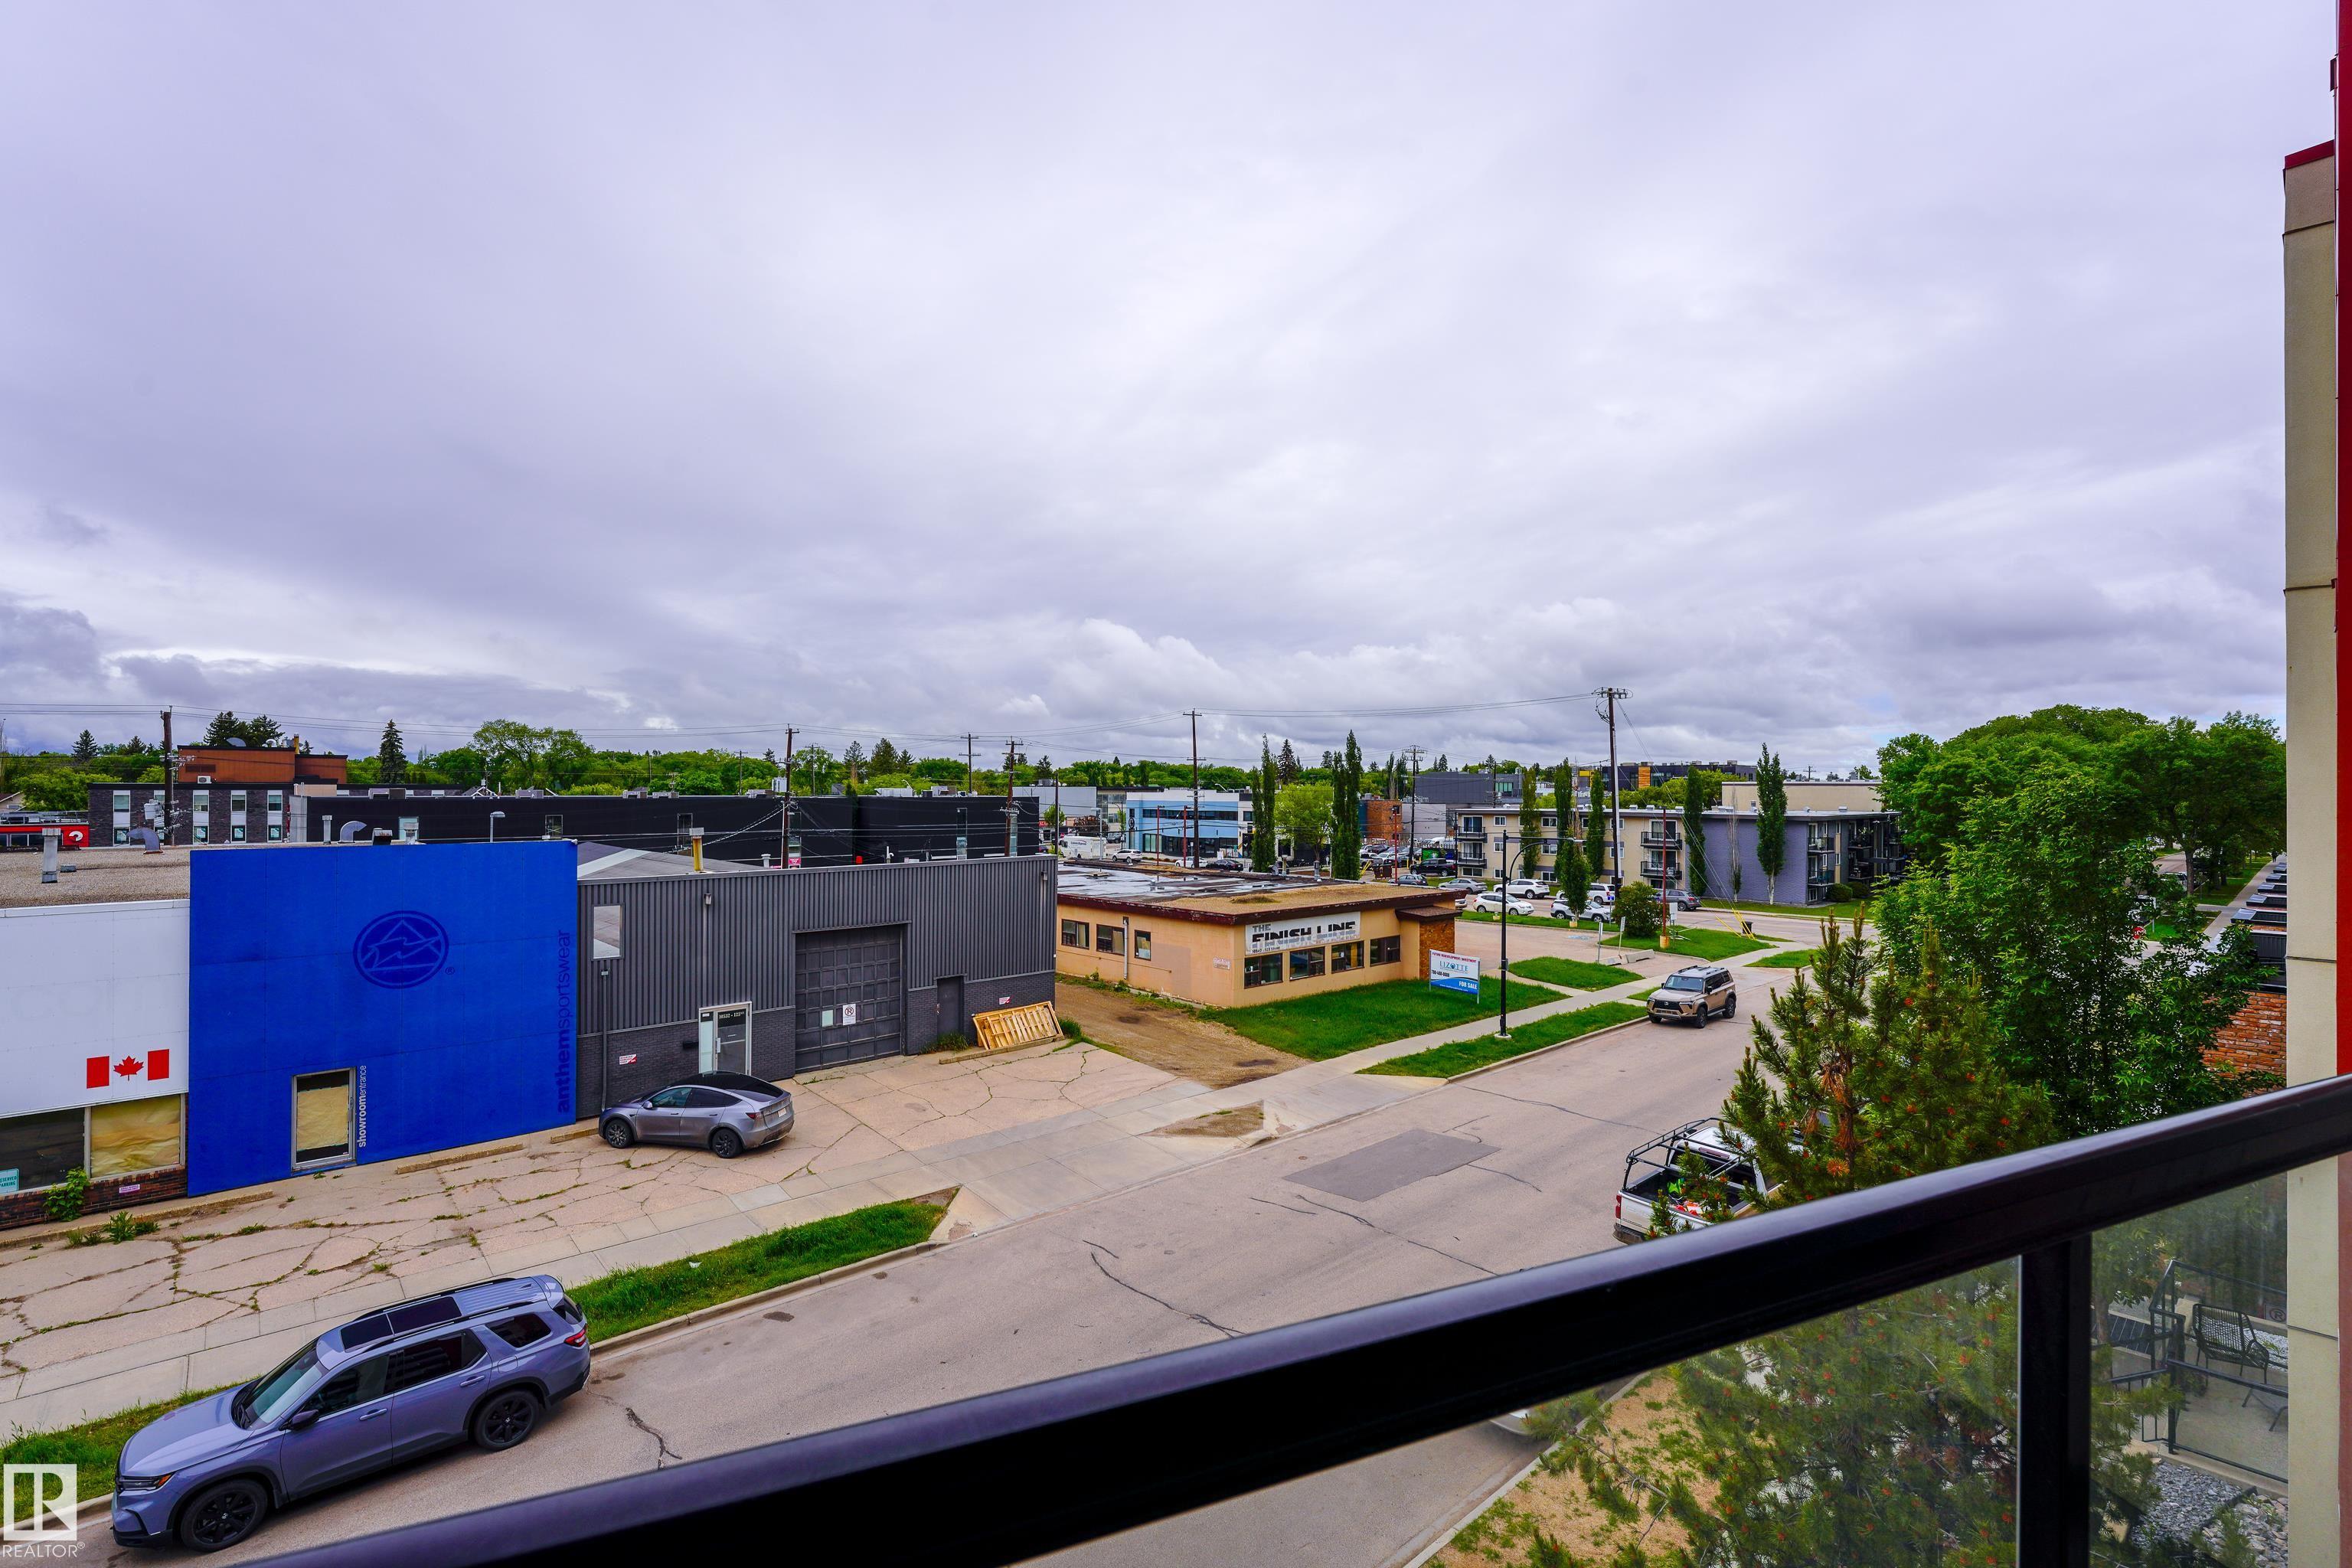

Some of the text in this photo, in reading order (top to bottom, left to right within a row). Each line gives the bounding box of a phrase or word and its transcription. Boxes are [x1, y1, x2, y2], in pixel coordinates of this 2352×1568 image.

[1253, 924, 1271, 933] THE
[1253, 927, 1312, 949] FINISH
[1317, 921, 1356, 939] LINE
[1439, 961, 1469, 972] LIZOTTE
[554, 930, 573, 1113] anthemsportswear
[357, 1065, 367, 1148] showroomentrance
